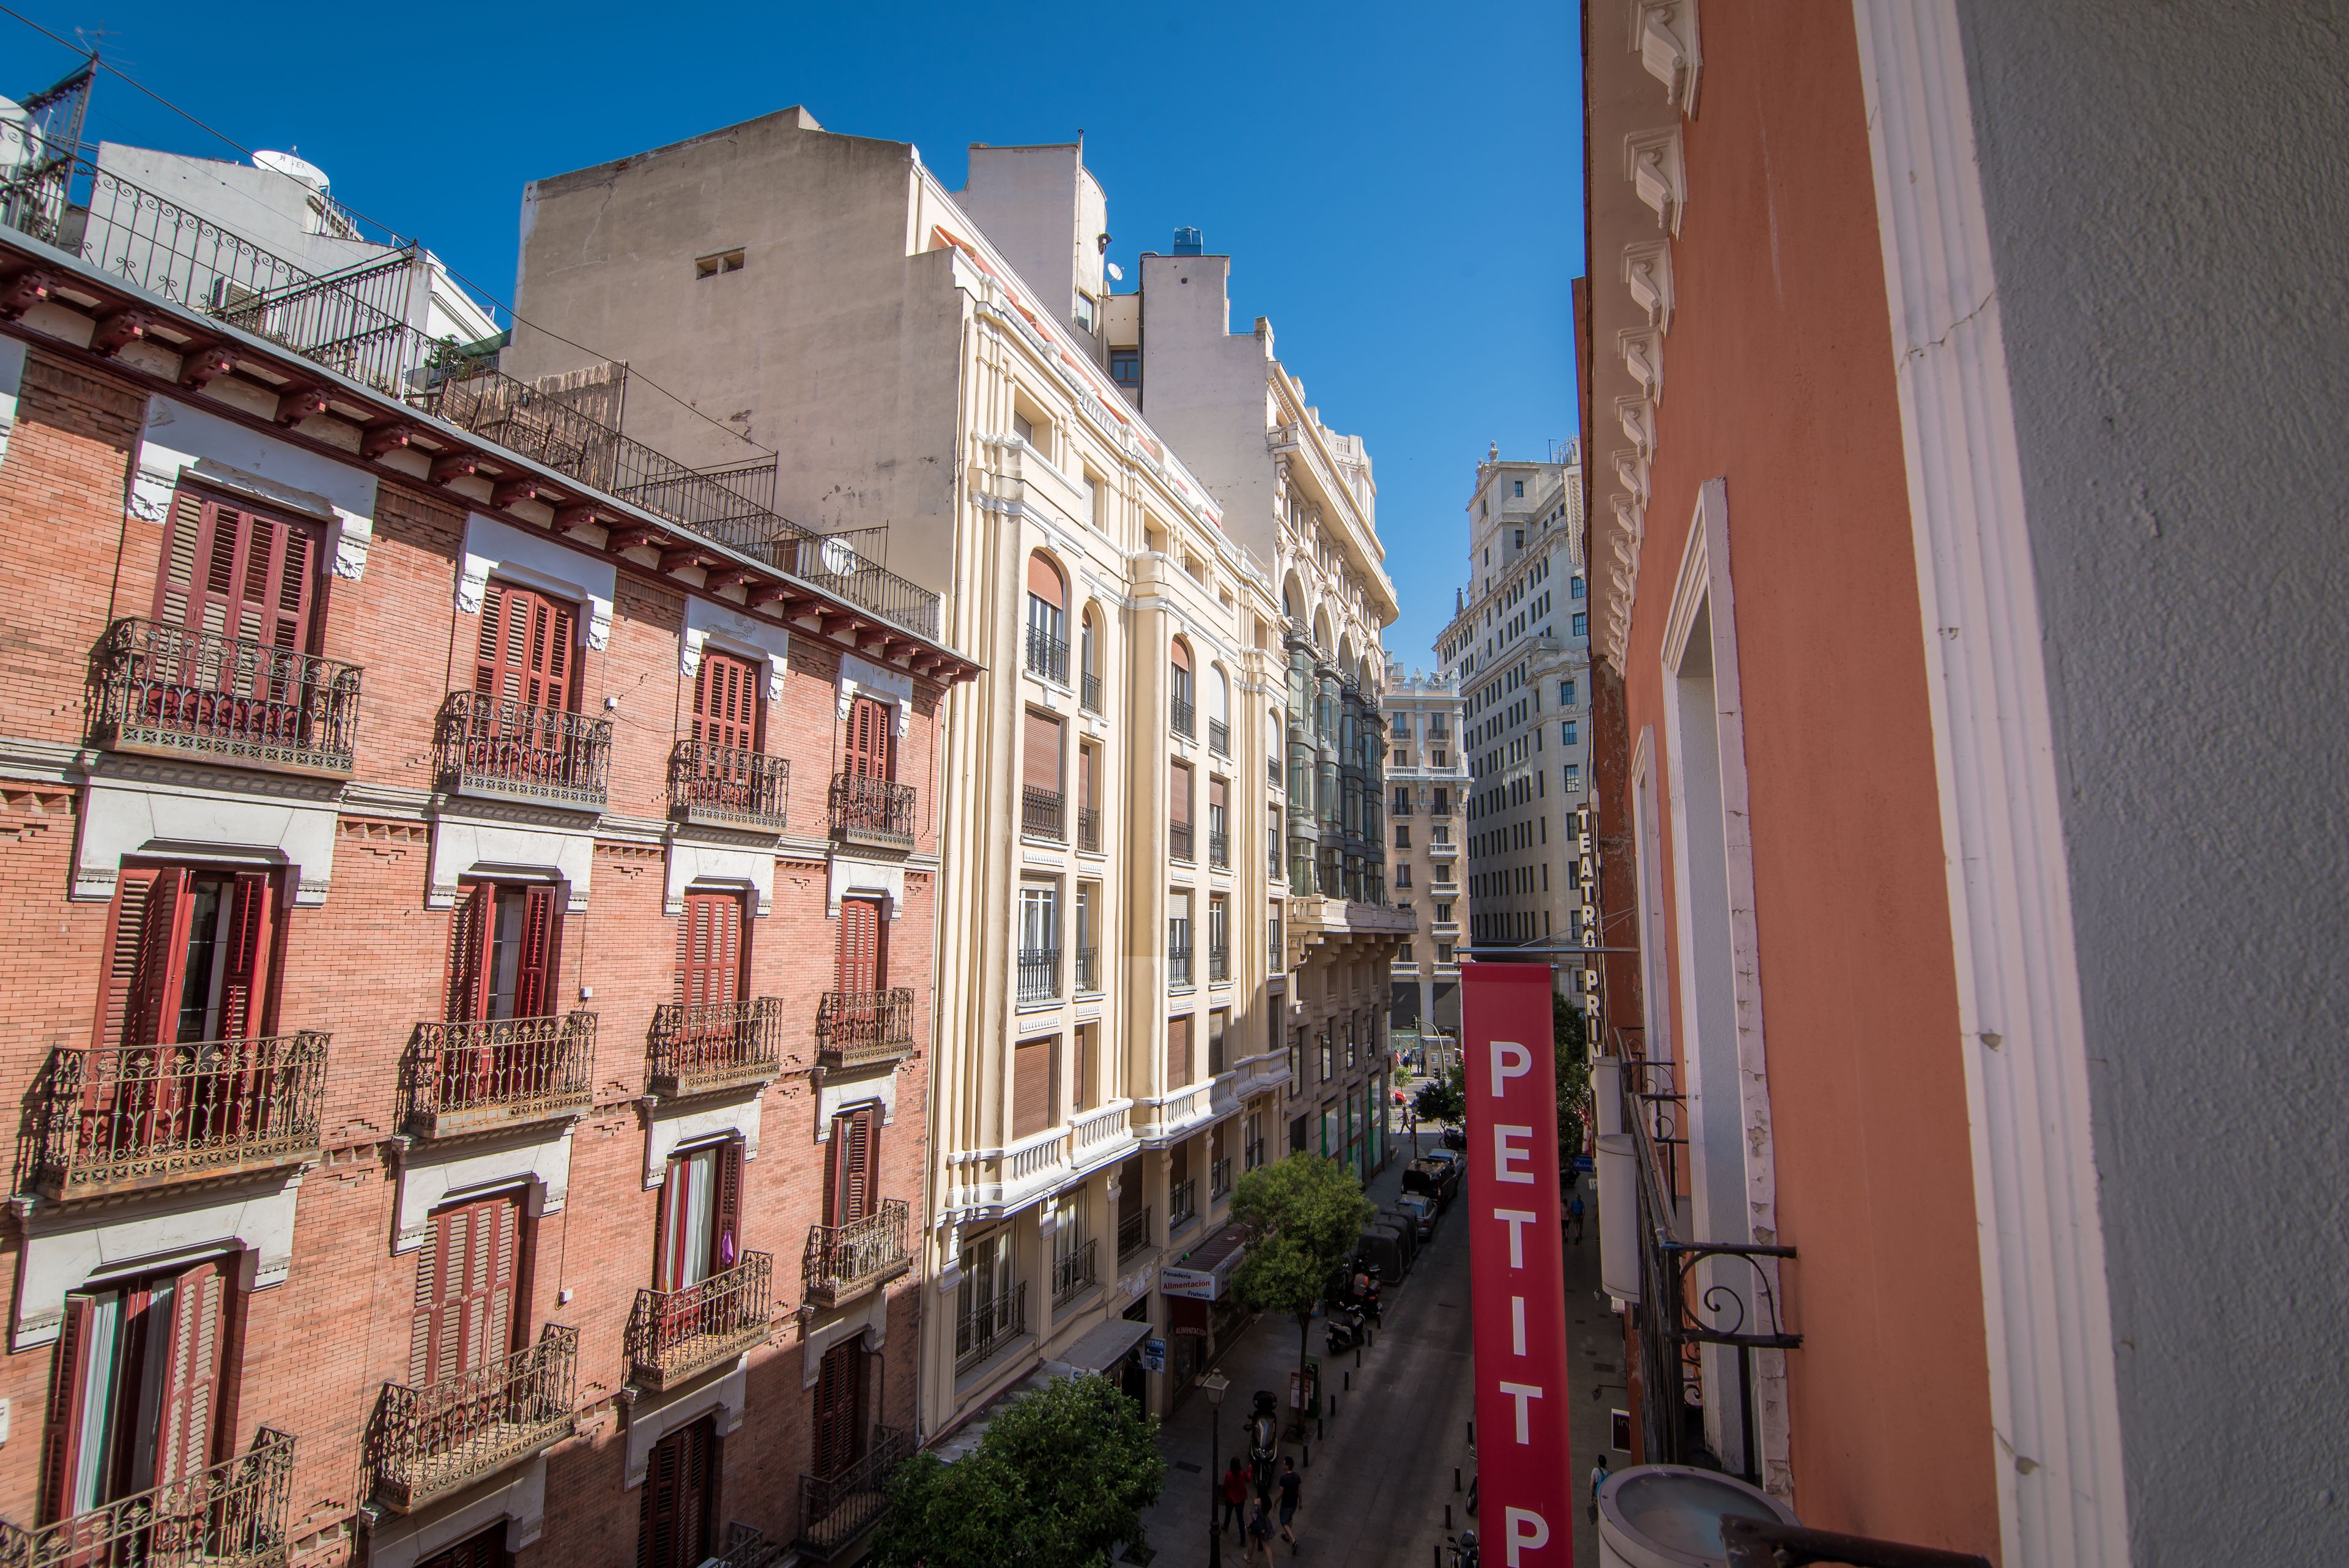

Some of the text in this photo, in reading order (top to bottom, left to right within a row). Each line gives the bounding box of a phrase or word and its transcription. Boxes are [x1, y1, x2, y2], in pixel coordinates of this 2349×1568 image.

[1578, 809, 1602, 1091] TEATRO PRIN
[1163, 1271, 1192, 1279] Panadería
[1163, 1279, 1210, 1290] Alimentación
[1490, 1041, 1549, 1568] PETIT P
